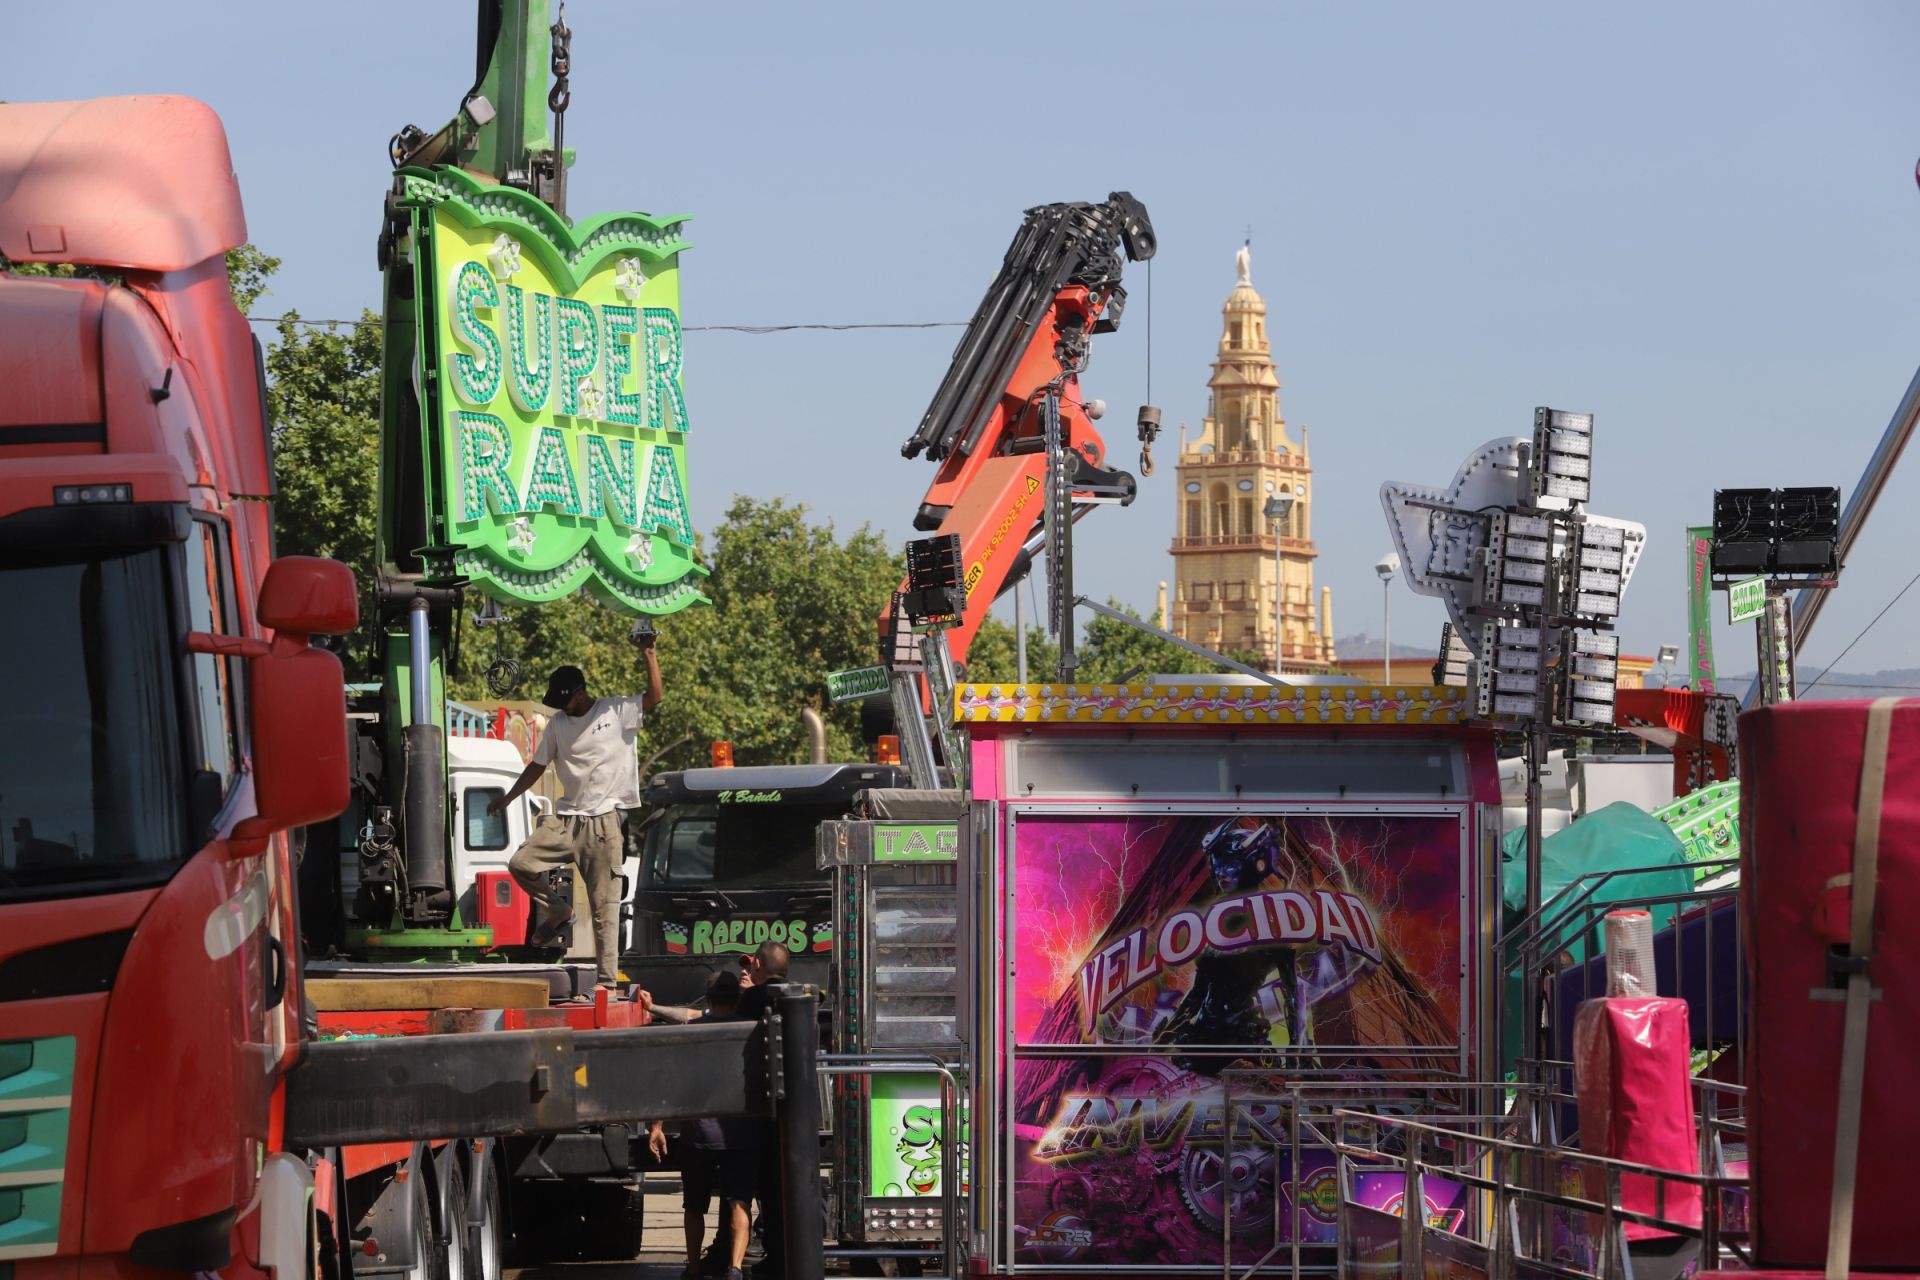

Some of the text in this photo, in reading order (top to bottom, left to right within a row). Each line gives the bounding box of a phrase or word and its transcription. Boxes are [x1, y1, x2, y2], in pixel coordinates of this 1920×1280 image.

[448, 261, 690, 434] SUPER
[450, 410, 696, 547] RANA
[982, 547, 994, 562] PK
[1733, 582, 1765, 617] SALIDA
[830, 668, 888, 698] ENTRADA
[693, 919, 808, 955] RAPIDOS
[1079, 889, 1384, 1036] VELOCIDAD
